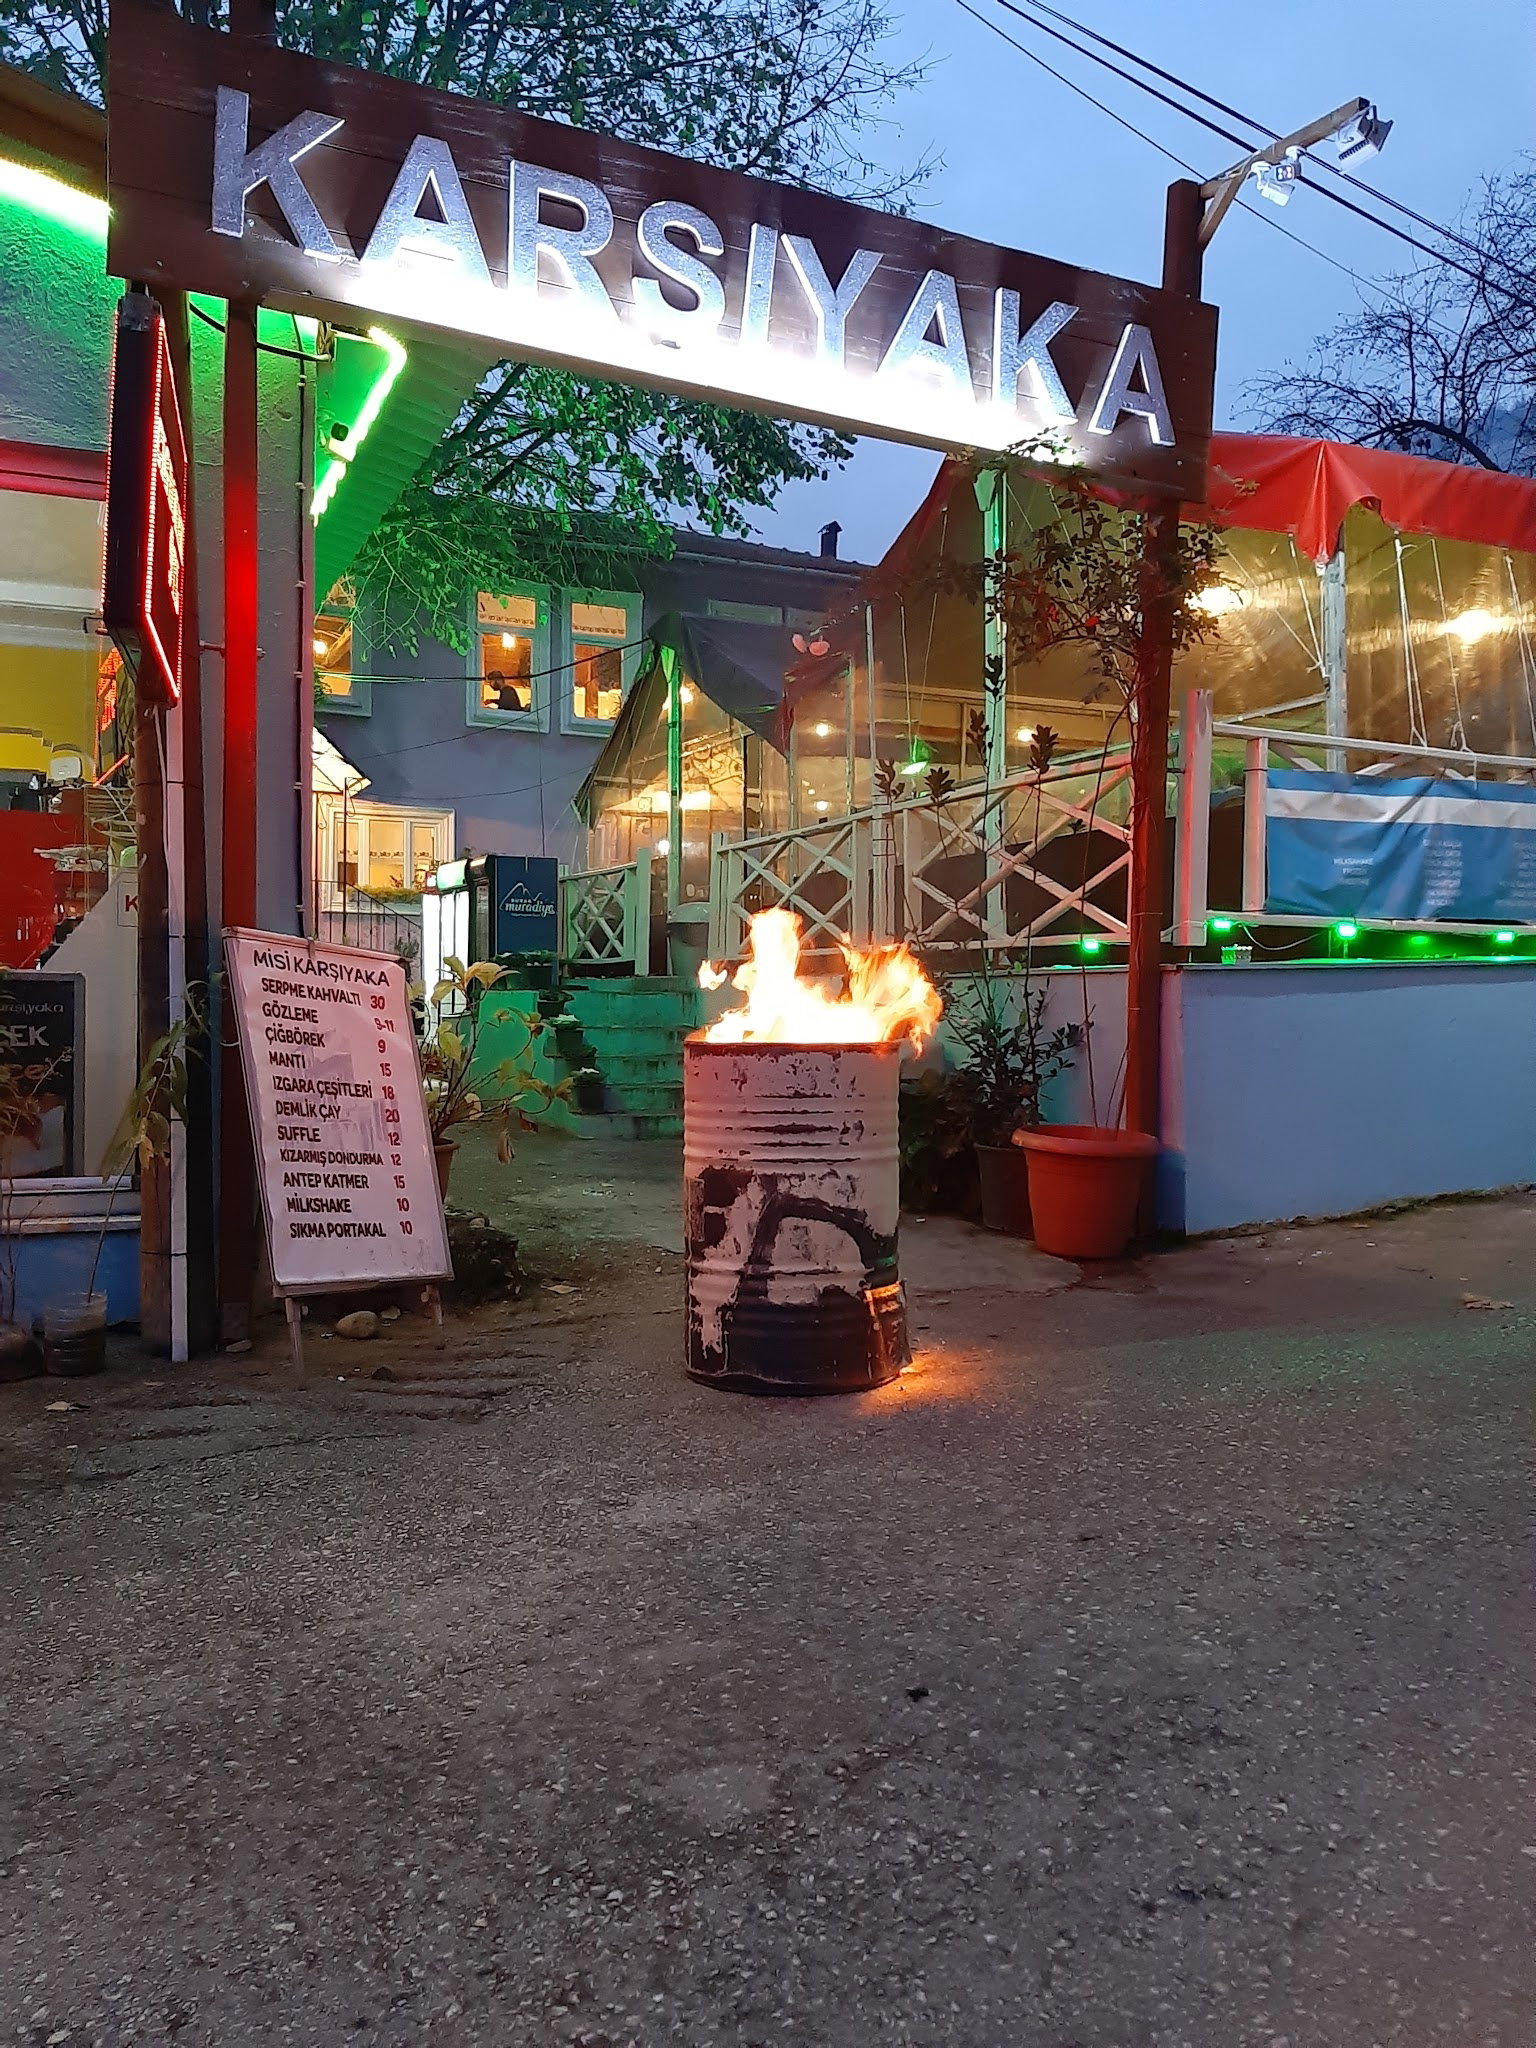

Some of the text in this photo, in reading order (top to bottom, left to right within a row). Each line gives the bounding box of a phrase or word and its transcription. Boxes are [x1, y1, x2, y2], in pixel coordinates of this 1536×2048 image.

[254, 948, 390, 987] MİSİ KARŞIYAKA
[262, 978, 385, 1010] SERPME KAHVALTI 30
[262, 1000, 319, 1024] GÖZLEME
[265, 1023, 386, 1054] ÇİĞBÖREK 9
[269, 1051, 392, 1076] MANTI 15
[273, 1076, 395, 1100] IZGARA ÇEŞİTLERİ 18
[276, 1098, 400, 1122] DEMLİK ÇAY 20
[278, 1125, 400, 1146] SUFFLE 12
[280, 1148, 402, 1167] KIZARMIŞ DONDURMA 12
[284, 1172, 406, 1189] ANTEP KATMER 15
[286, 1192, 410, 1212] MİLKSHAKE 10
[290, 1221, 412, 1238] SIKMA PORTAKAL 10
